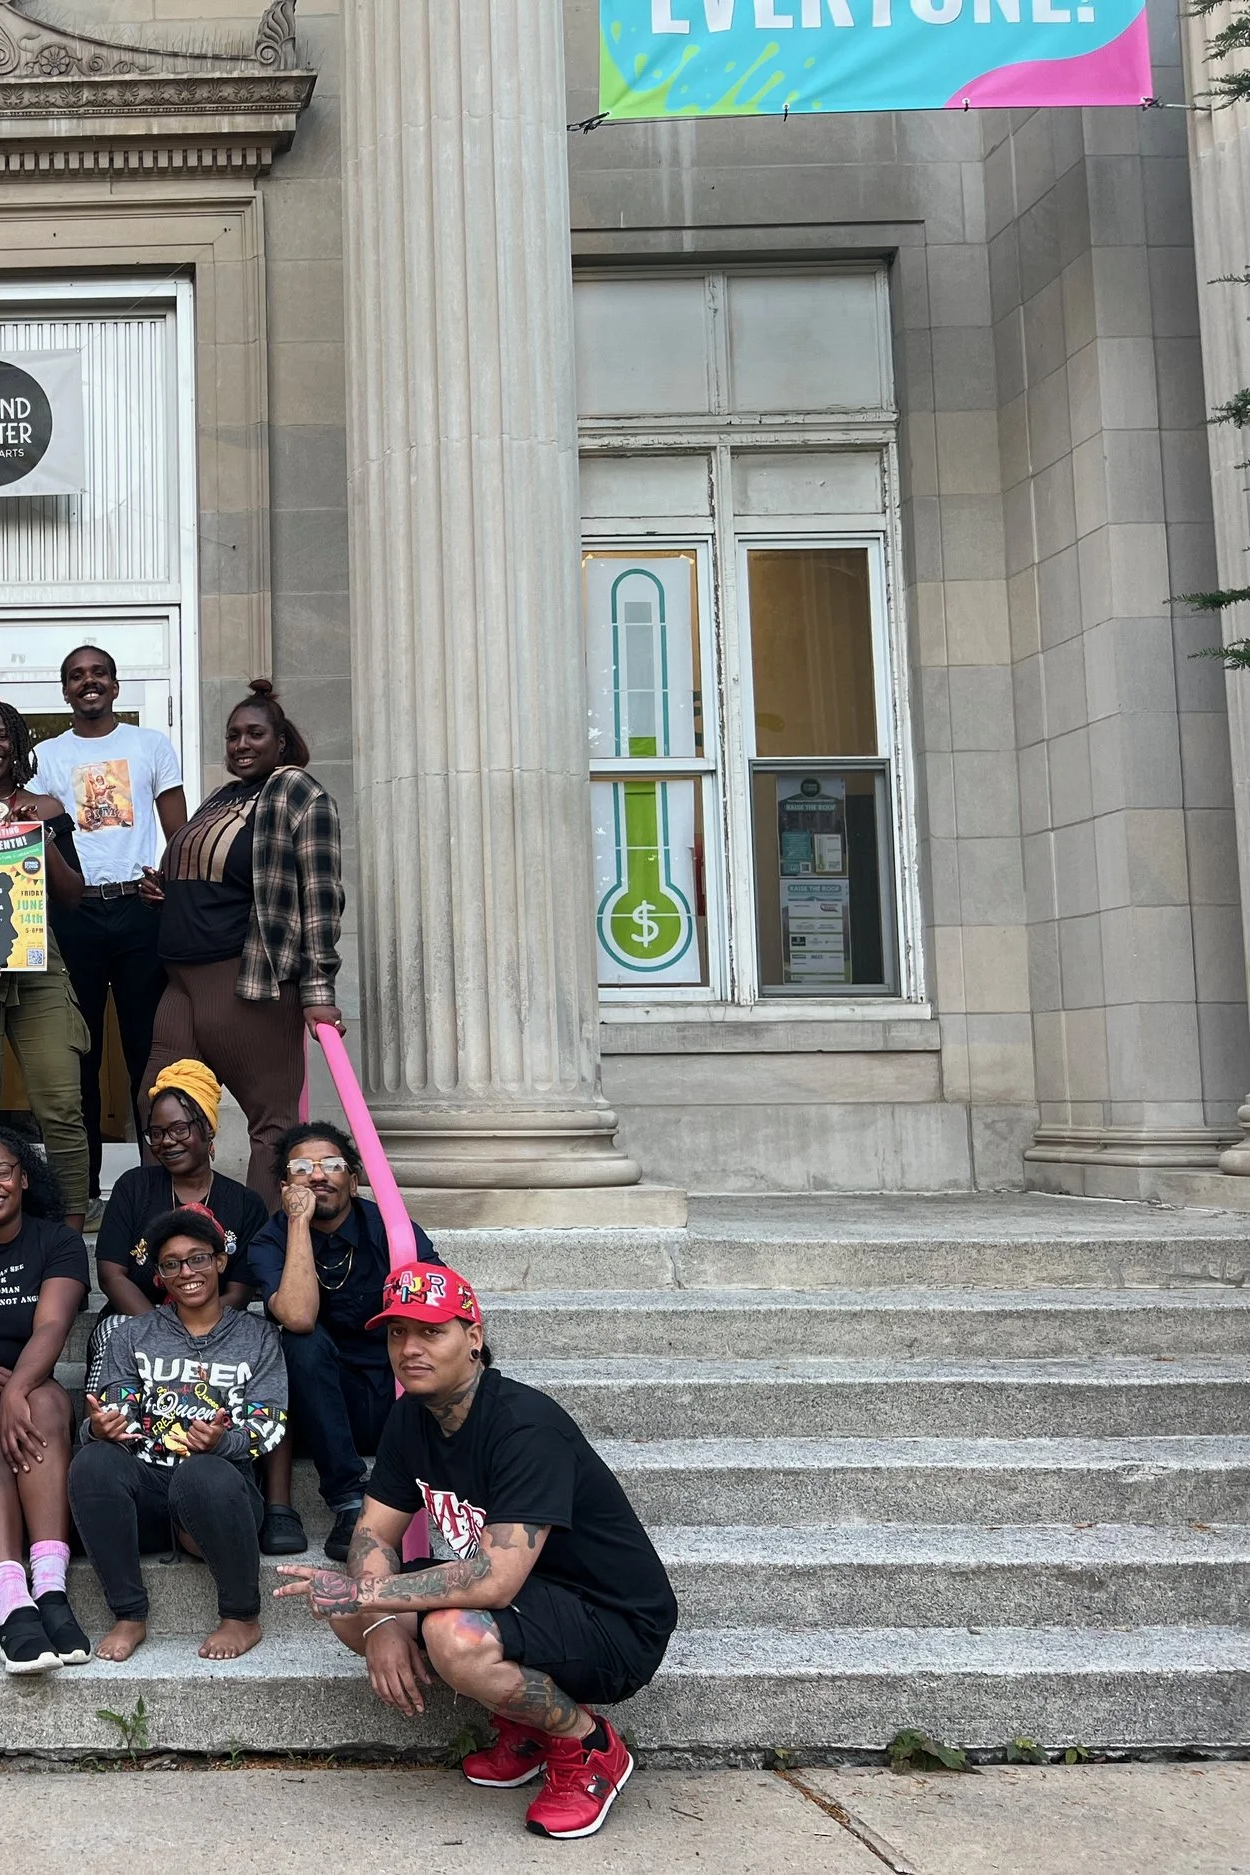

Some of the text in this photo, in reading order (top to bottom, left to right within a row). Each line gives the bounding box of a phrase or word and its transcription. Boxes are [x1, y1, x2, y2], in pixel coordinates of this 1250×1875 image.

[0, 448, 25, 458] ARTS
[17, 899, 45, 911] JUNE
[20, 913, 43, 925] 14th
[10, 1263, 25, 1273] SEE
[0, 1297, 18, 1306] NOT
[20, 1295, 39, 1304] ANG
[194, 1382, 220, 1410] Queen
[152, 1391, 217, 1420] Queen
